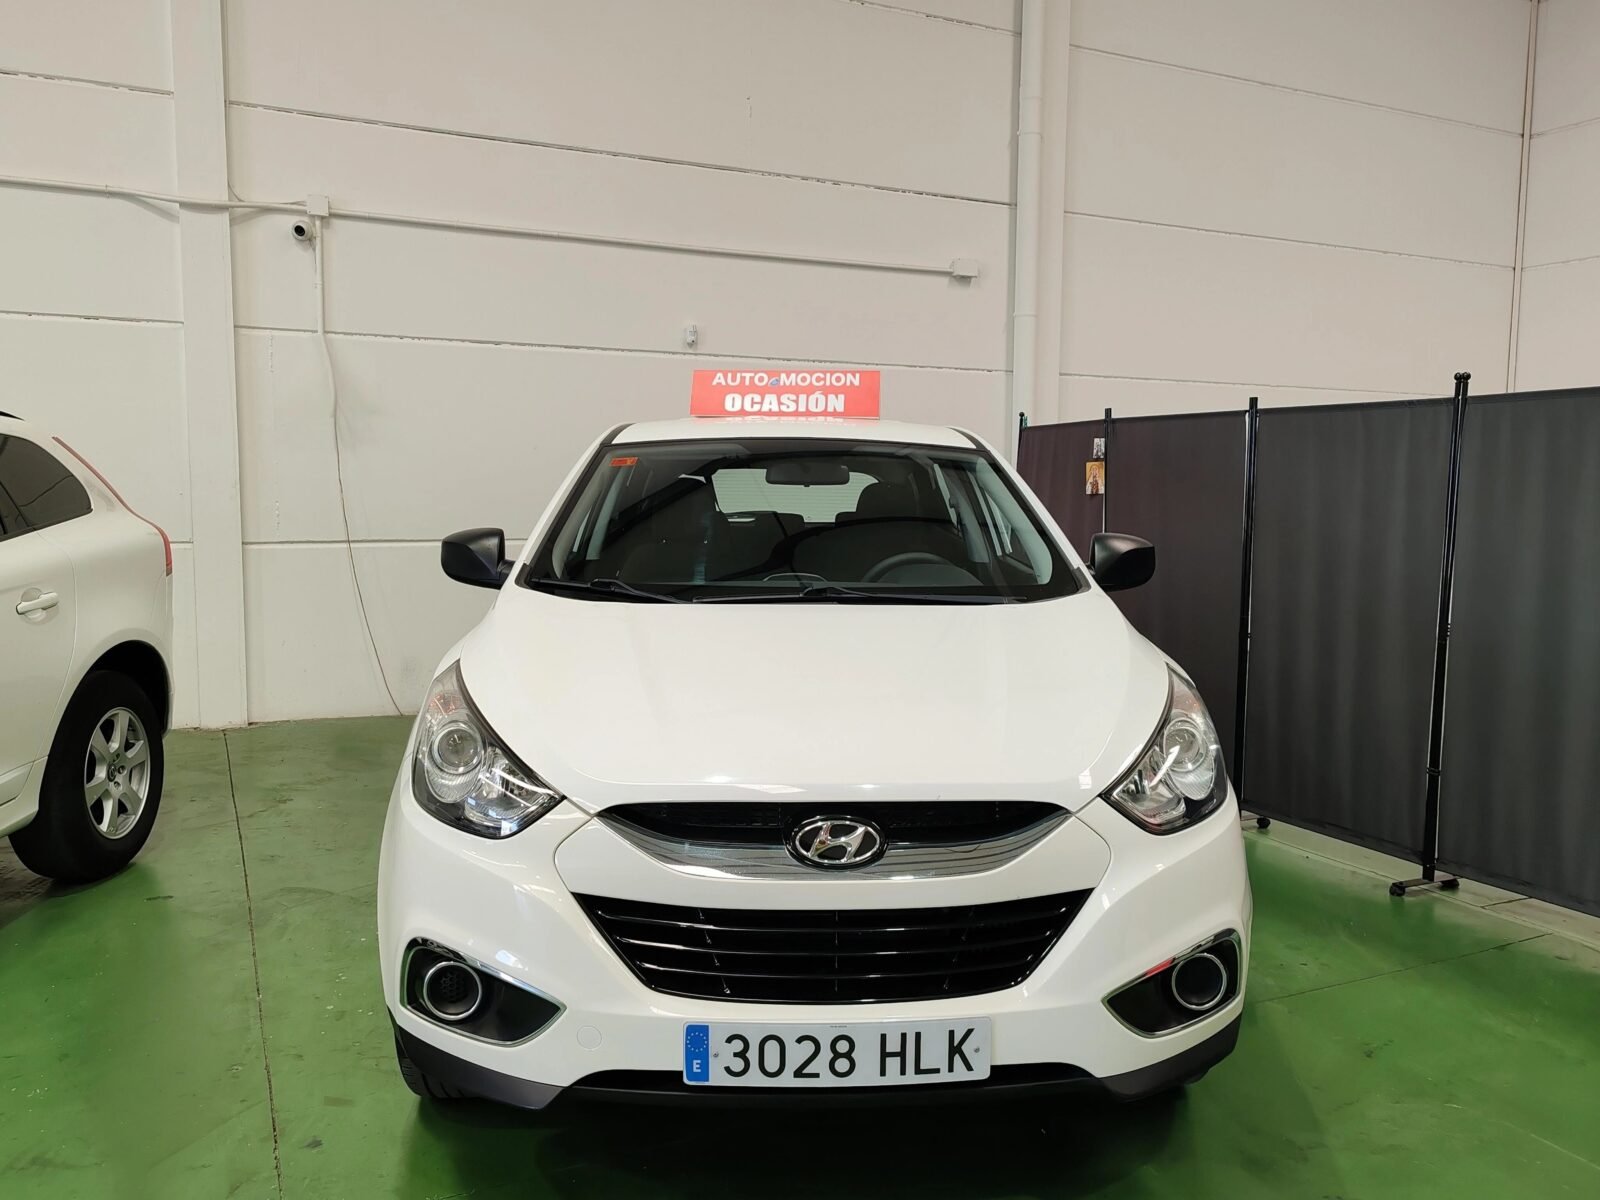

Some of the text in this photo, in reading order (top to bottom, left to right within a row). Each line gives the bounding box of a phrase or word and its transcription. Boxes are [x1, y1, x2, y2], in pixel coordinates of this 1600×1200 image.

[724, 391, 845, 412] OCASIÓN
[723, 1027, 976, 1079] 3028 HLK
[692, 1059, 702, 1073] E
